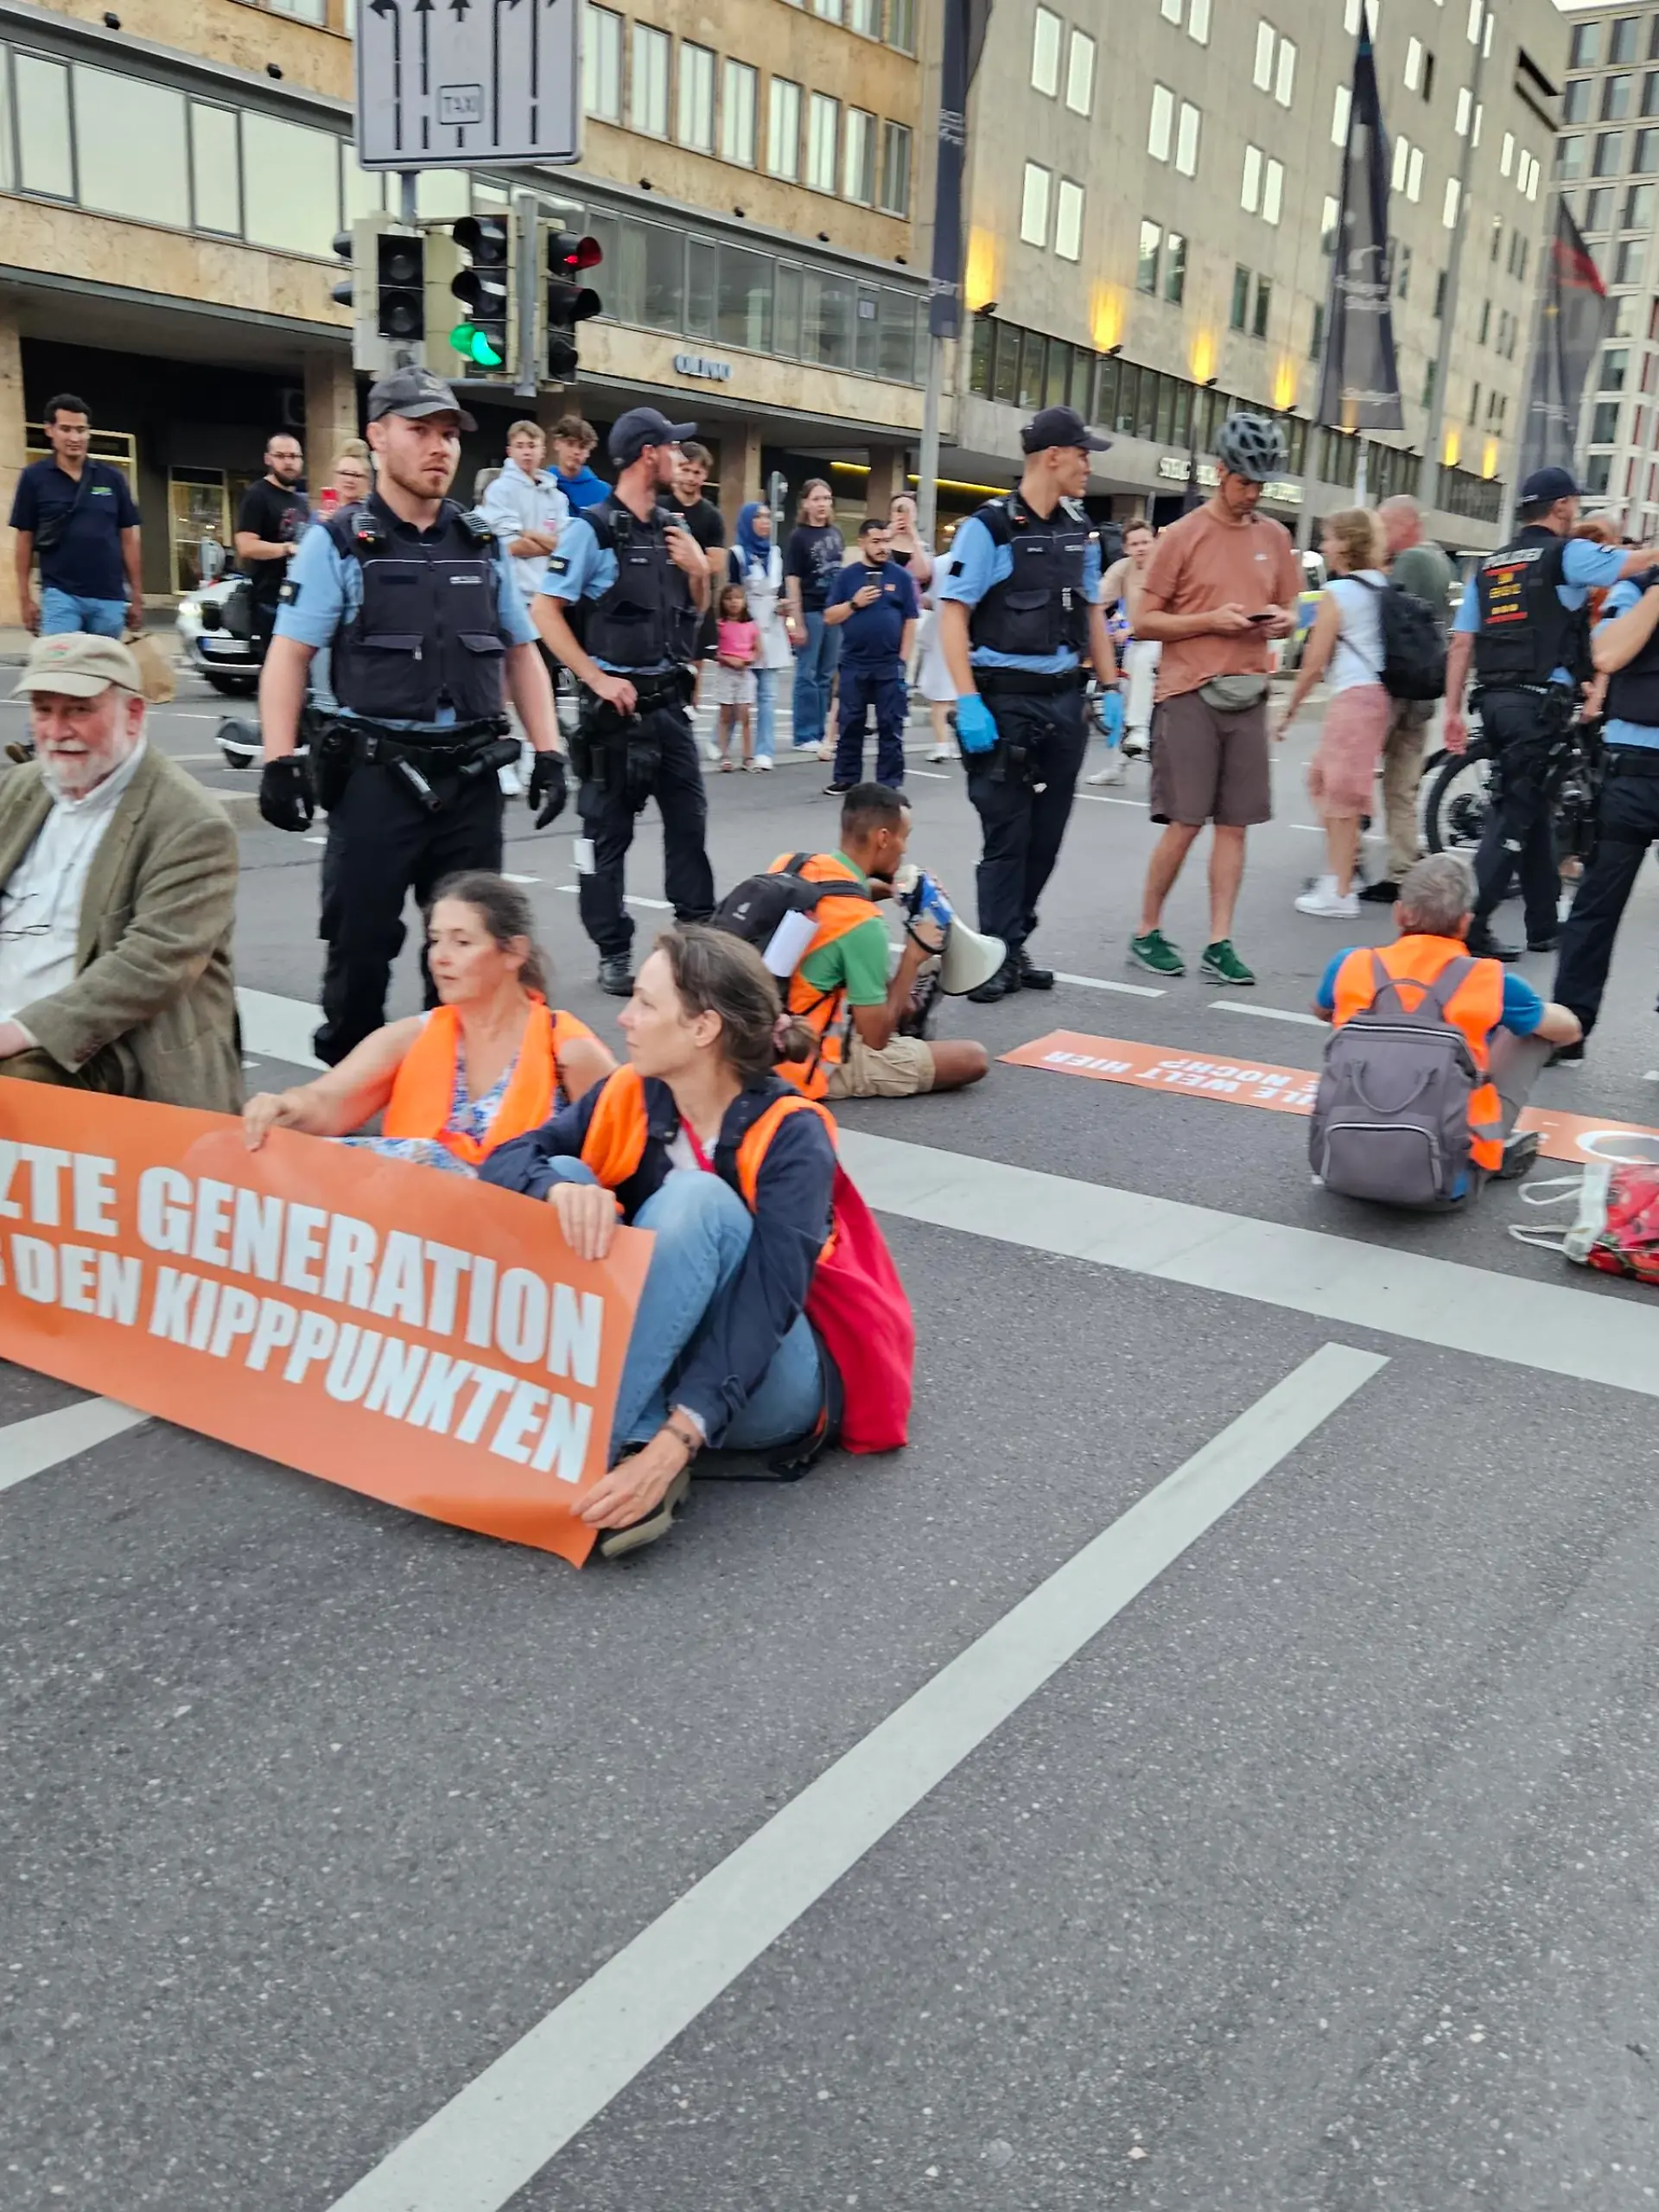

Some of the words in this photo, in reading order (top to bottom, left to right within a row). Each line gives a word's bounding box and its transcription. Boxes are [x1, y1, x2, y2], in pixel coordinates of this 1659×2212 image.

[1044, 1052, 1131, 1073] HIER
[1160, 1059, 1291, 1085] NOCH?
[1135, 1069, 1240, 1093] WELT
[137, 1166, 603, 1389] GENERATION
[10, 1232, 143, 1326] DEN
[148, 1265, 594, 1484] KIPPPUNKTEN
